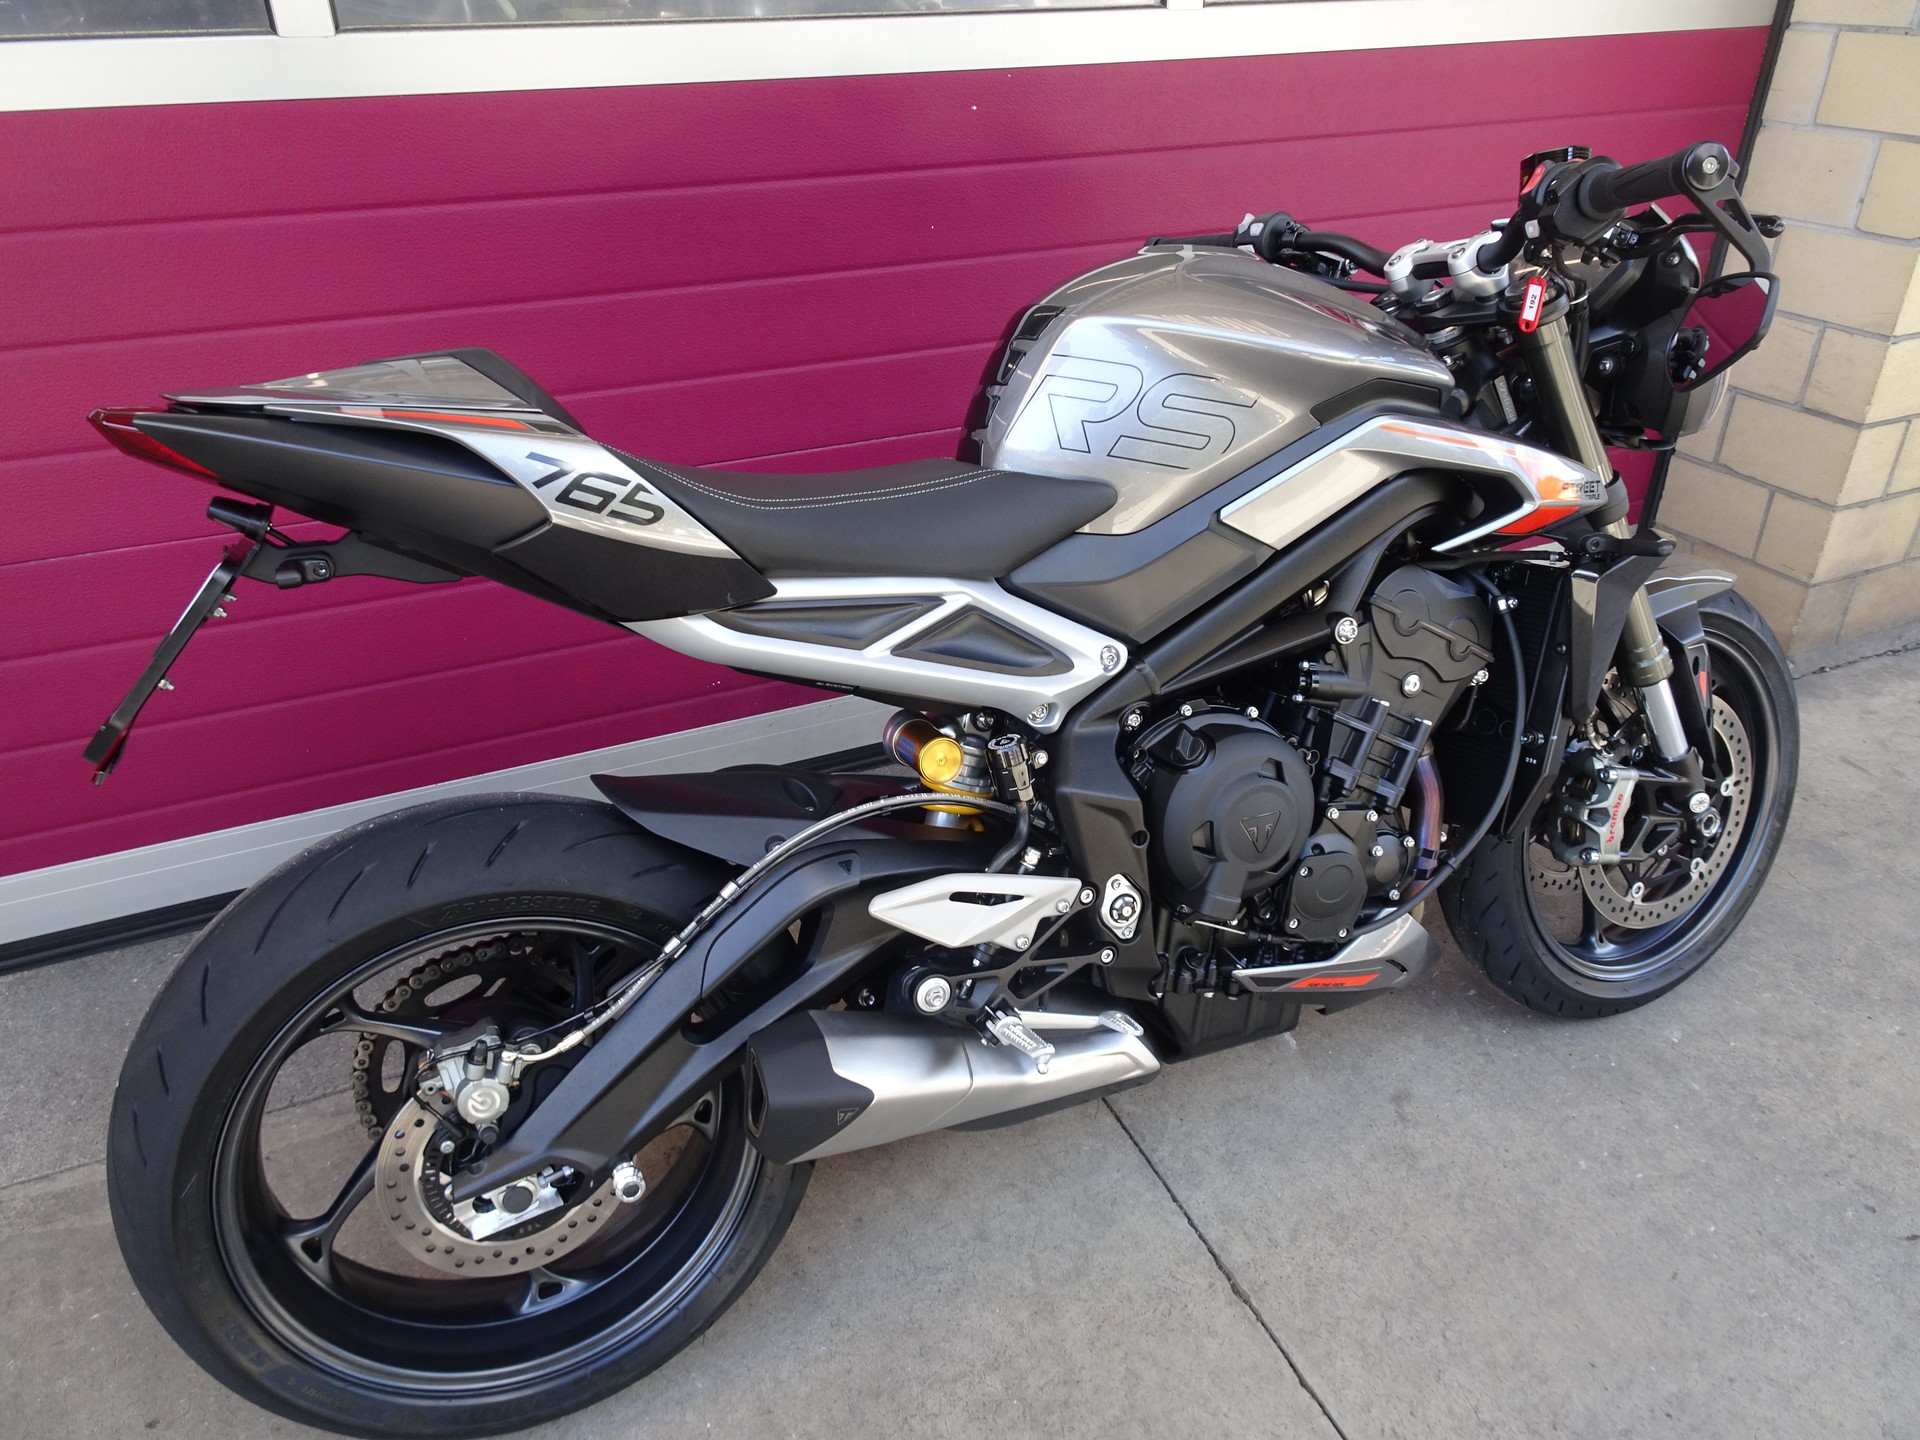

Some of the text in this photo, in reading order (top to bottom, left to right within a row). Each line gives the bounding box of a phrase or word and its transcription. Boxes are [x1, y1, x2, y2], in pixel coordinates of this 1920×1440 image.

[1529, 294, 1537, 310] 192
[1005, 353, 1261, 470] RS
[525, 451, 665, 526] 765
[1562, 479, 1601, 494] STREET
[1606, 793, 1624, 844] brembo
